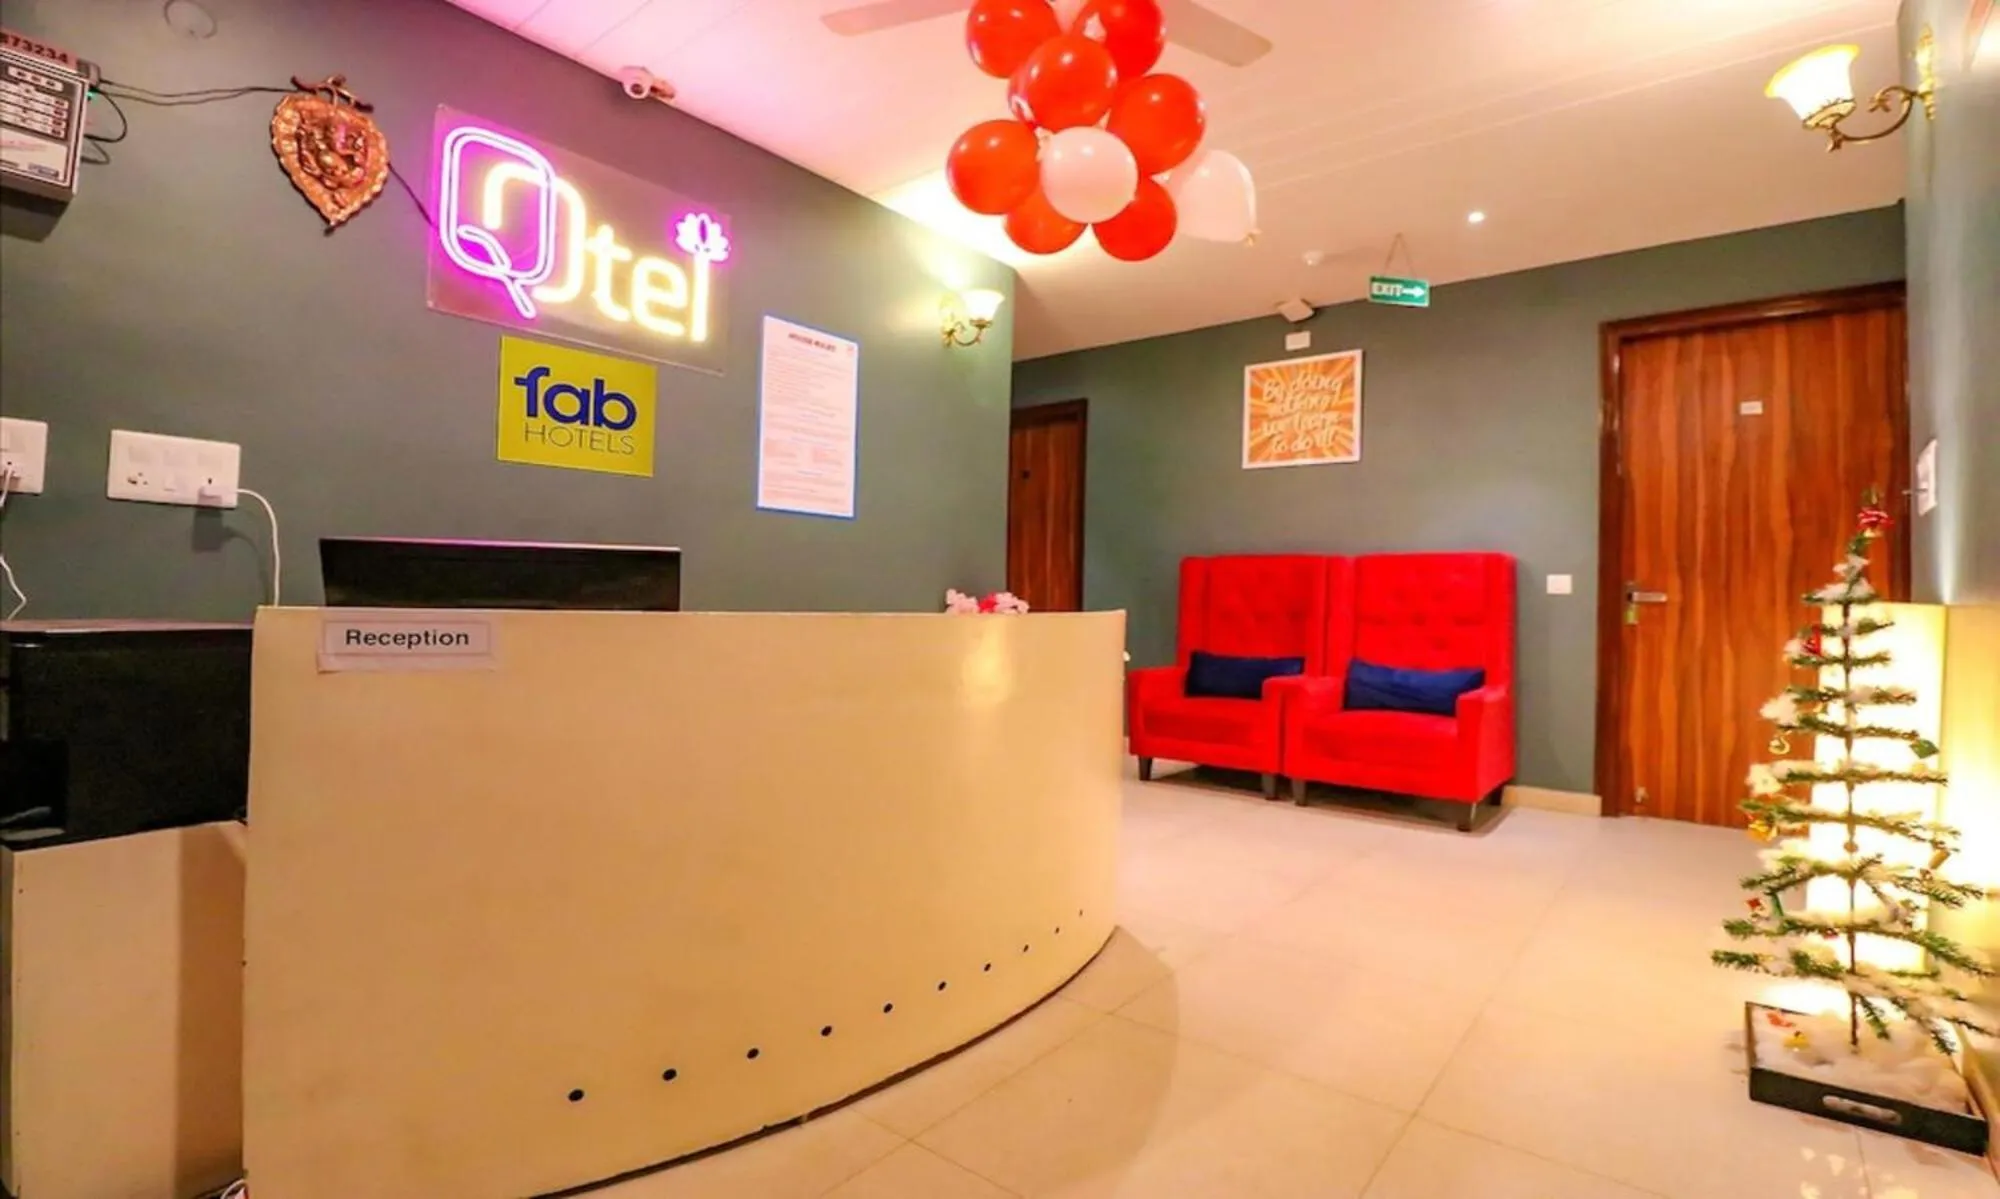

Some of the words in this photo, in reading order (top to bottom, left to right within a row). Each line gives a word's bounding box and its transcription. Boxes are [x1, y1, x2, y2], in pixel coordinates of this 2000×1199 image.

[1372, 282, 1403, 297] EXIT
[514, 366, 637, 431] fab
[1291, 370, 1342, 404] doing
[524, 422, 635, 455] HOTELS
[1290, 432, 1313, 452] do
[345, 629, 470, 649] Reception
